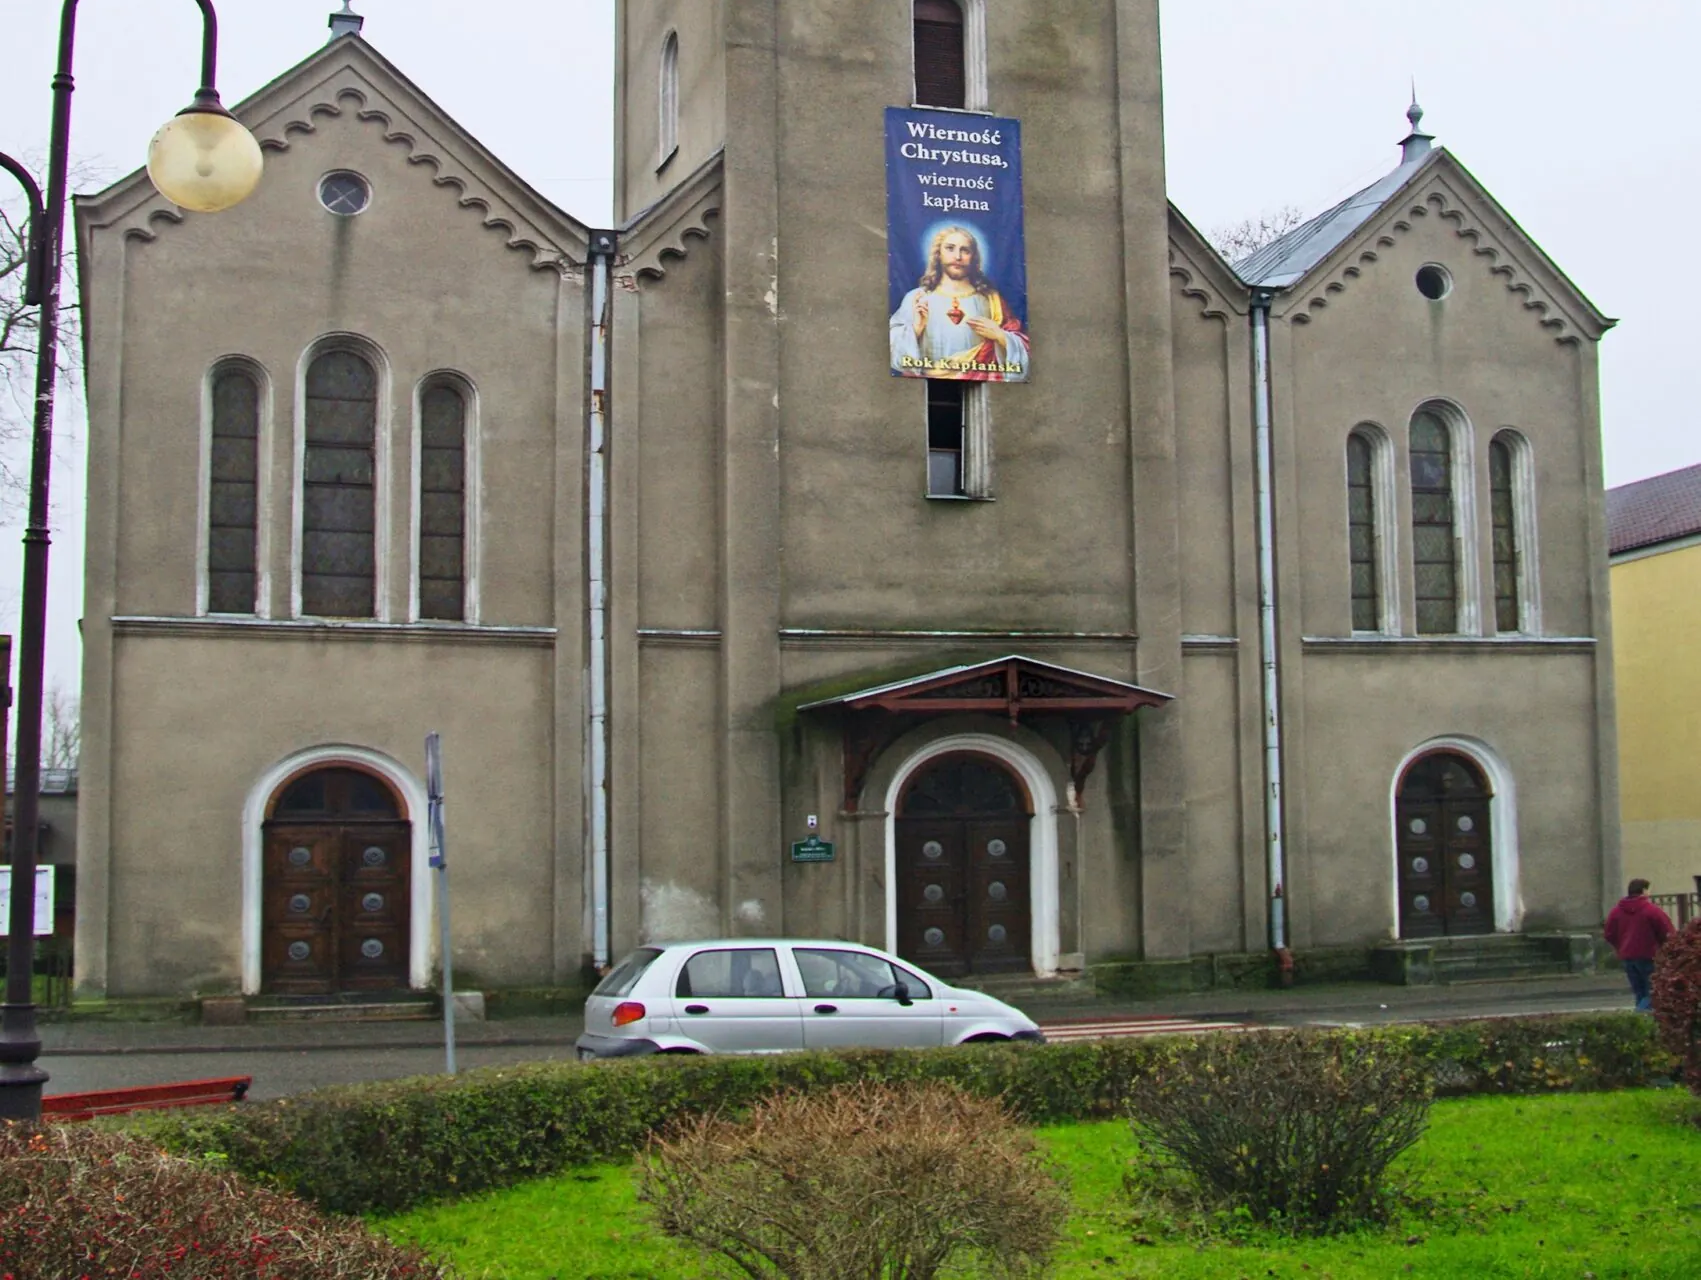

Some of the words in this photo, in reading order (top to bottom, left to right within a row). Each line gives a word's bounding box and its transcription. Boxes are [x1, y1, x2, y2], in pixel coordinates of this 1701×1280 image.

[906, 121, 1002, 145] Wierność
[900, 142, 1008, 168] Chrystusa,
[917, 172, 994, 190] wierność
[923, 192, 990, 211] kapłana
[902, 355, 933, 369] Rok
[940, 358, 1022, 373] Kapłański
